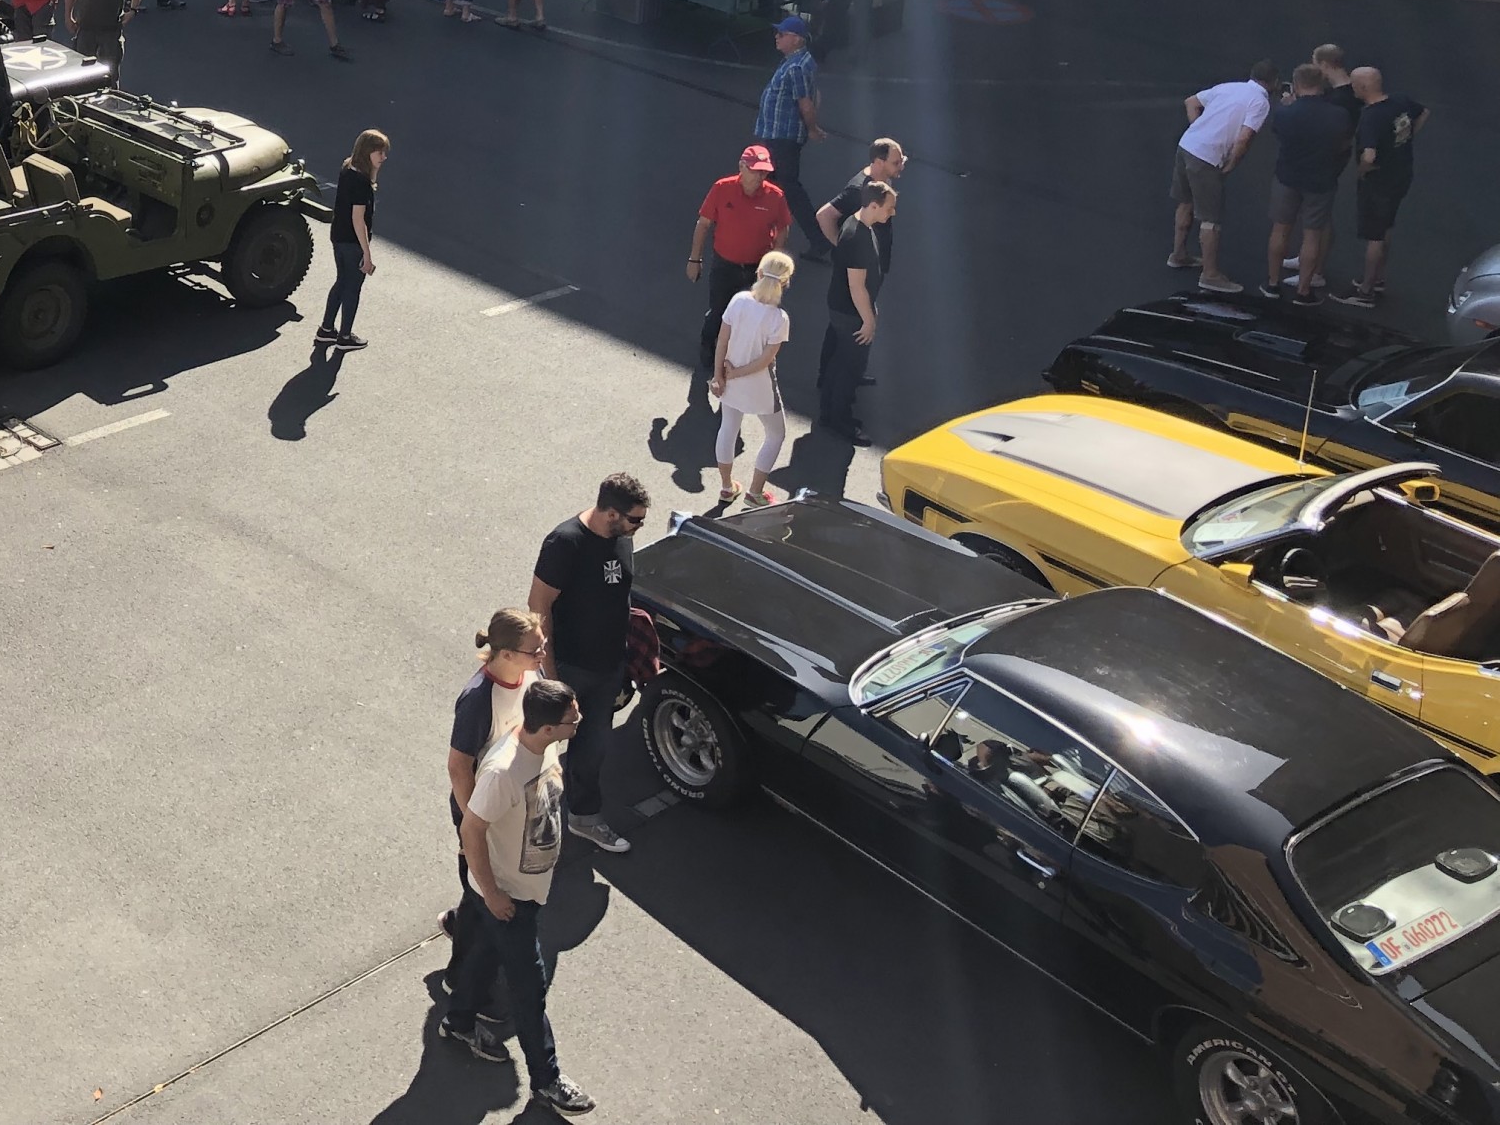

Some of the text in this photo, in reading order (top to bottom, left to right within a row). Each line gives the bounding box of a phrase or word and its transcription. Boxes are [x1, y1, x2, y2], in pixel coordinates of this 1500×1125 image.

[1380, 911, 1458, 960] OF 060272
[1186, 1038, 1273, 1067] AMERICAN
[1275, 1071, 1298, 1096] GT
